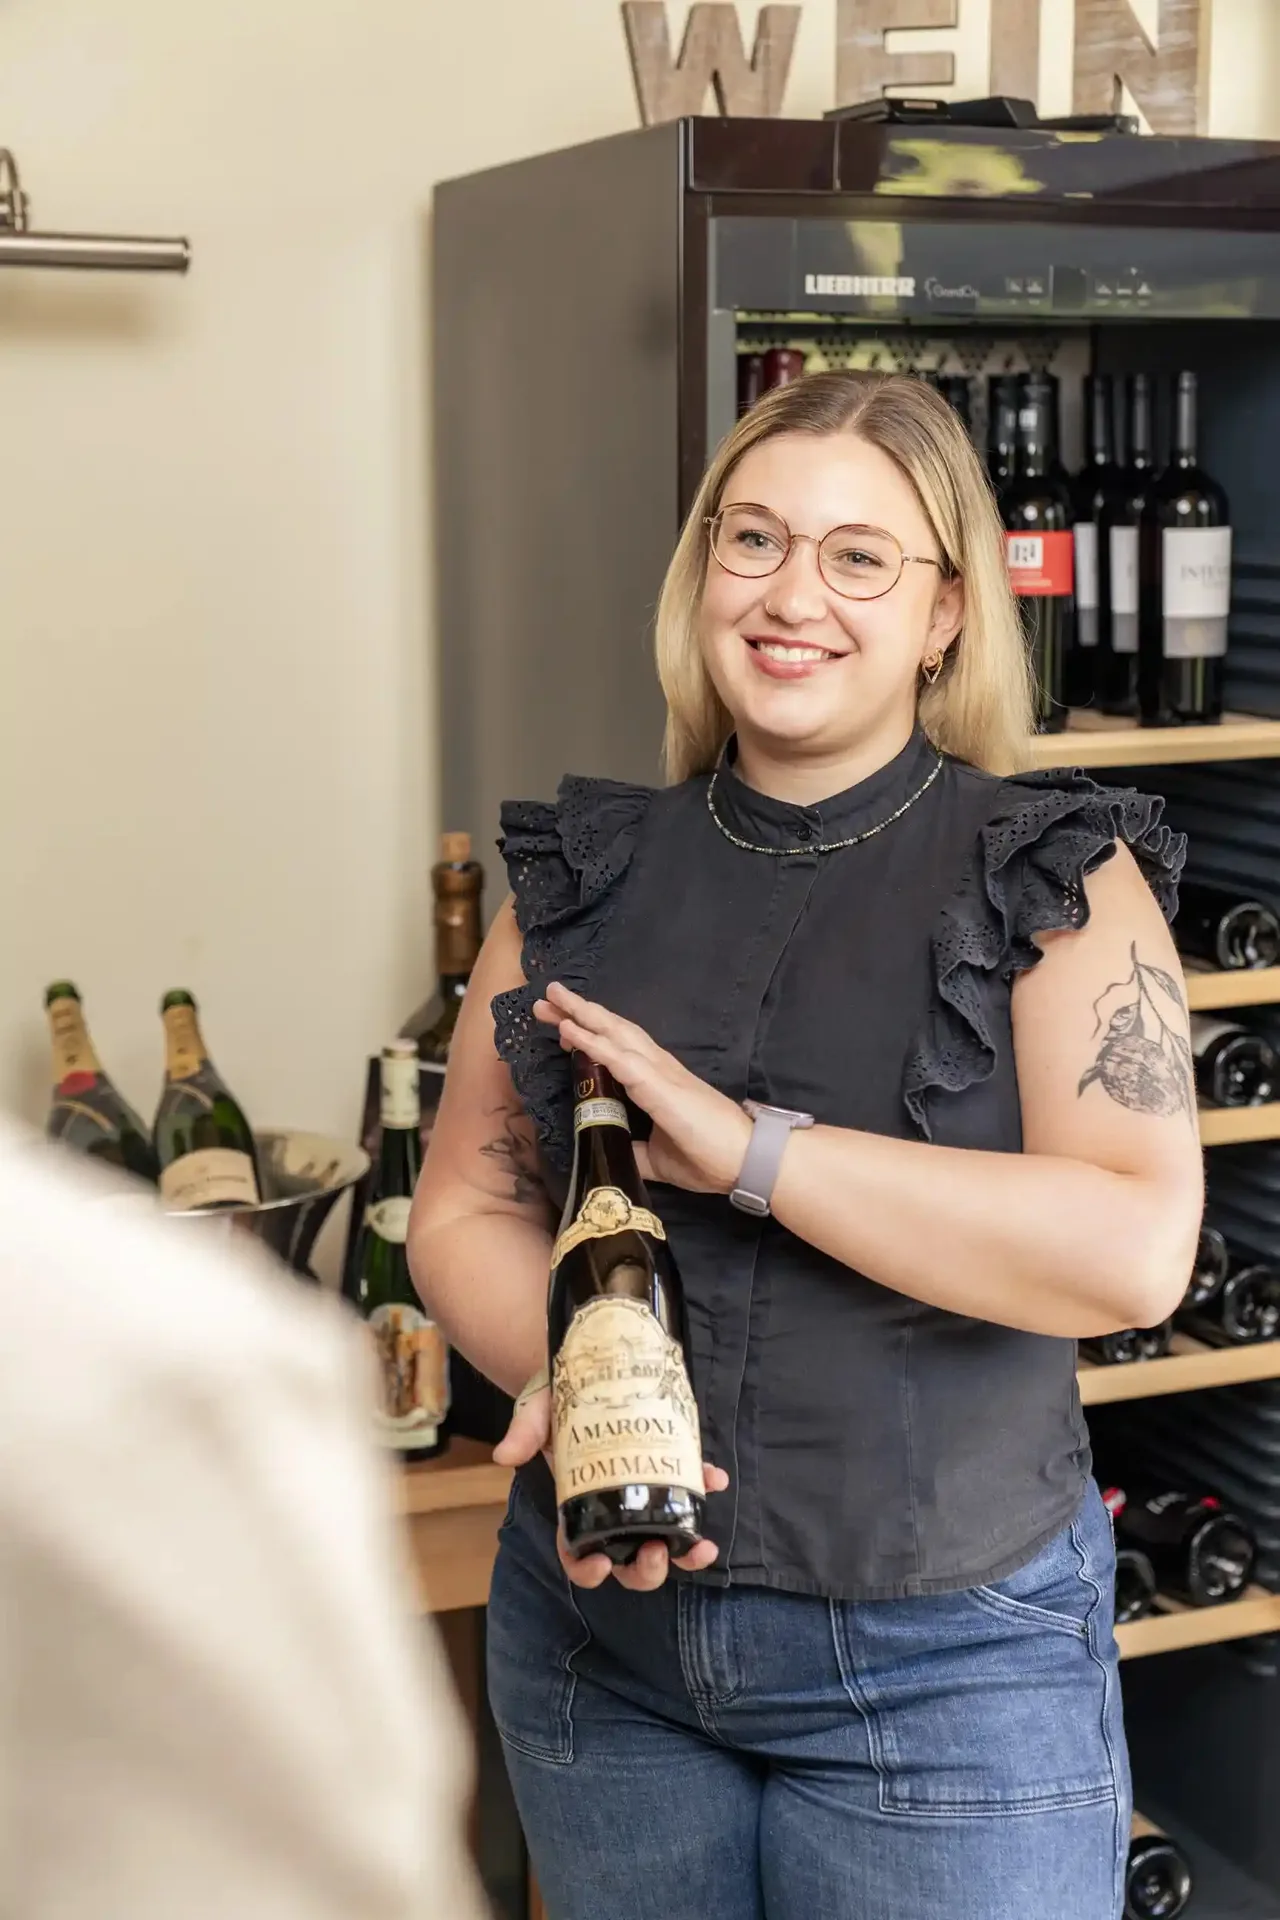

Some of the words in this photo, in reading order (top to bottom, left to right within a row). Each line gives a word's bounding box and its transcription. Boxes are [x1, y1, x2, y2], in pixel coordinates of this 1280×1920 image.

[622, 0, 1211, 136] WEIN
[805, 274, 915, 297] LIEBHERR
[569, 1417, 679, 1444] AMARONE
[569, 1454, 682, 1487] TOMMASI
